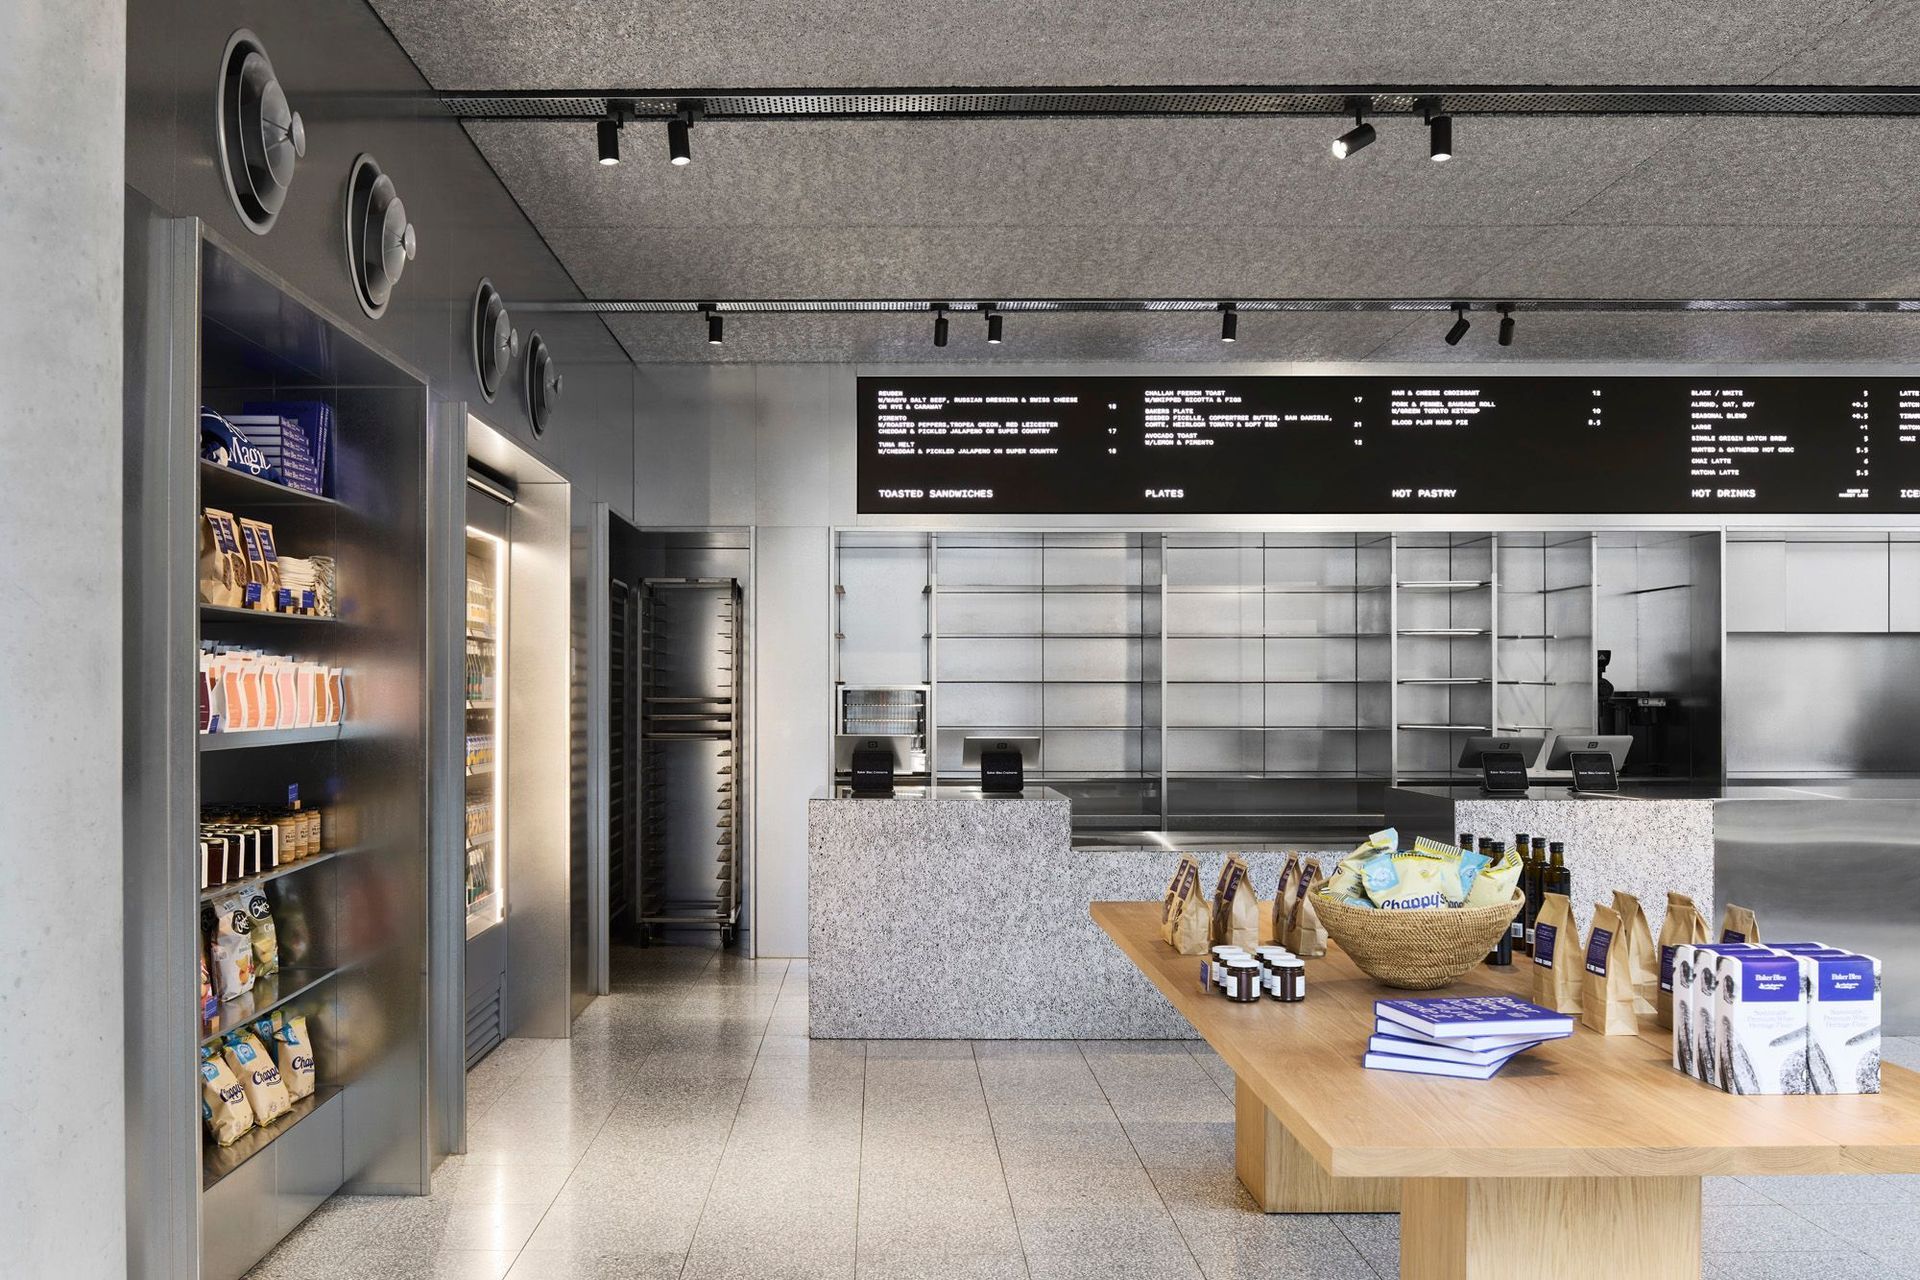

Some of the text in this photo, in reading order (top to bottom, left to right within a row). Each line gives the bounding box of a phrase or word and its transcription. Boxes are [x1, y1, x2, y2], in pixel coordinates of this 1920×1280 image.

[1185, 396, 1214, 404] RICOTTA
[1710, 457, 1732, 465] LATTE
[878, 489, 994, 498] TOASTED SANDWICHES
[1145, 489, 1184, 498] PLATES
[1392, 489, 1457, 498] HOT PASTRY
[1691, 488, 1756, 498] HOT DRINKS
